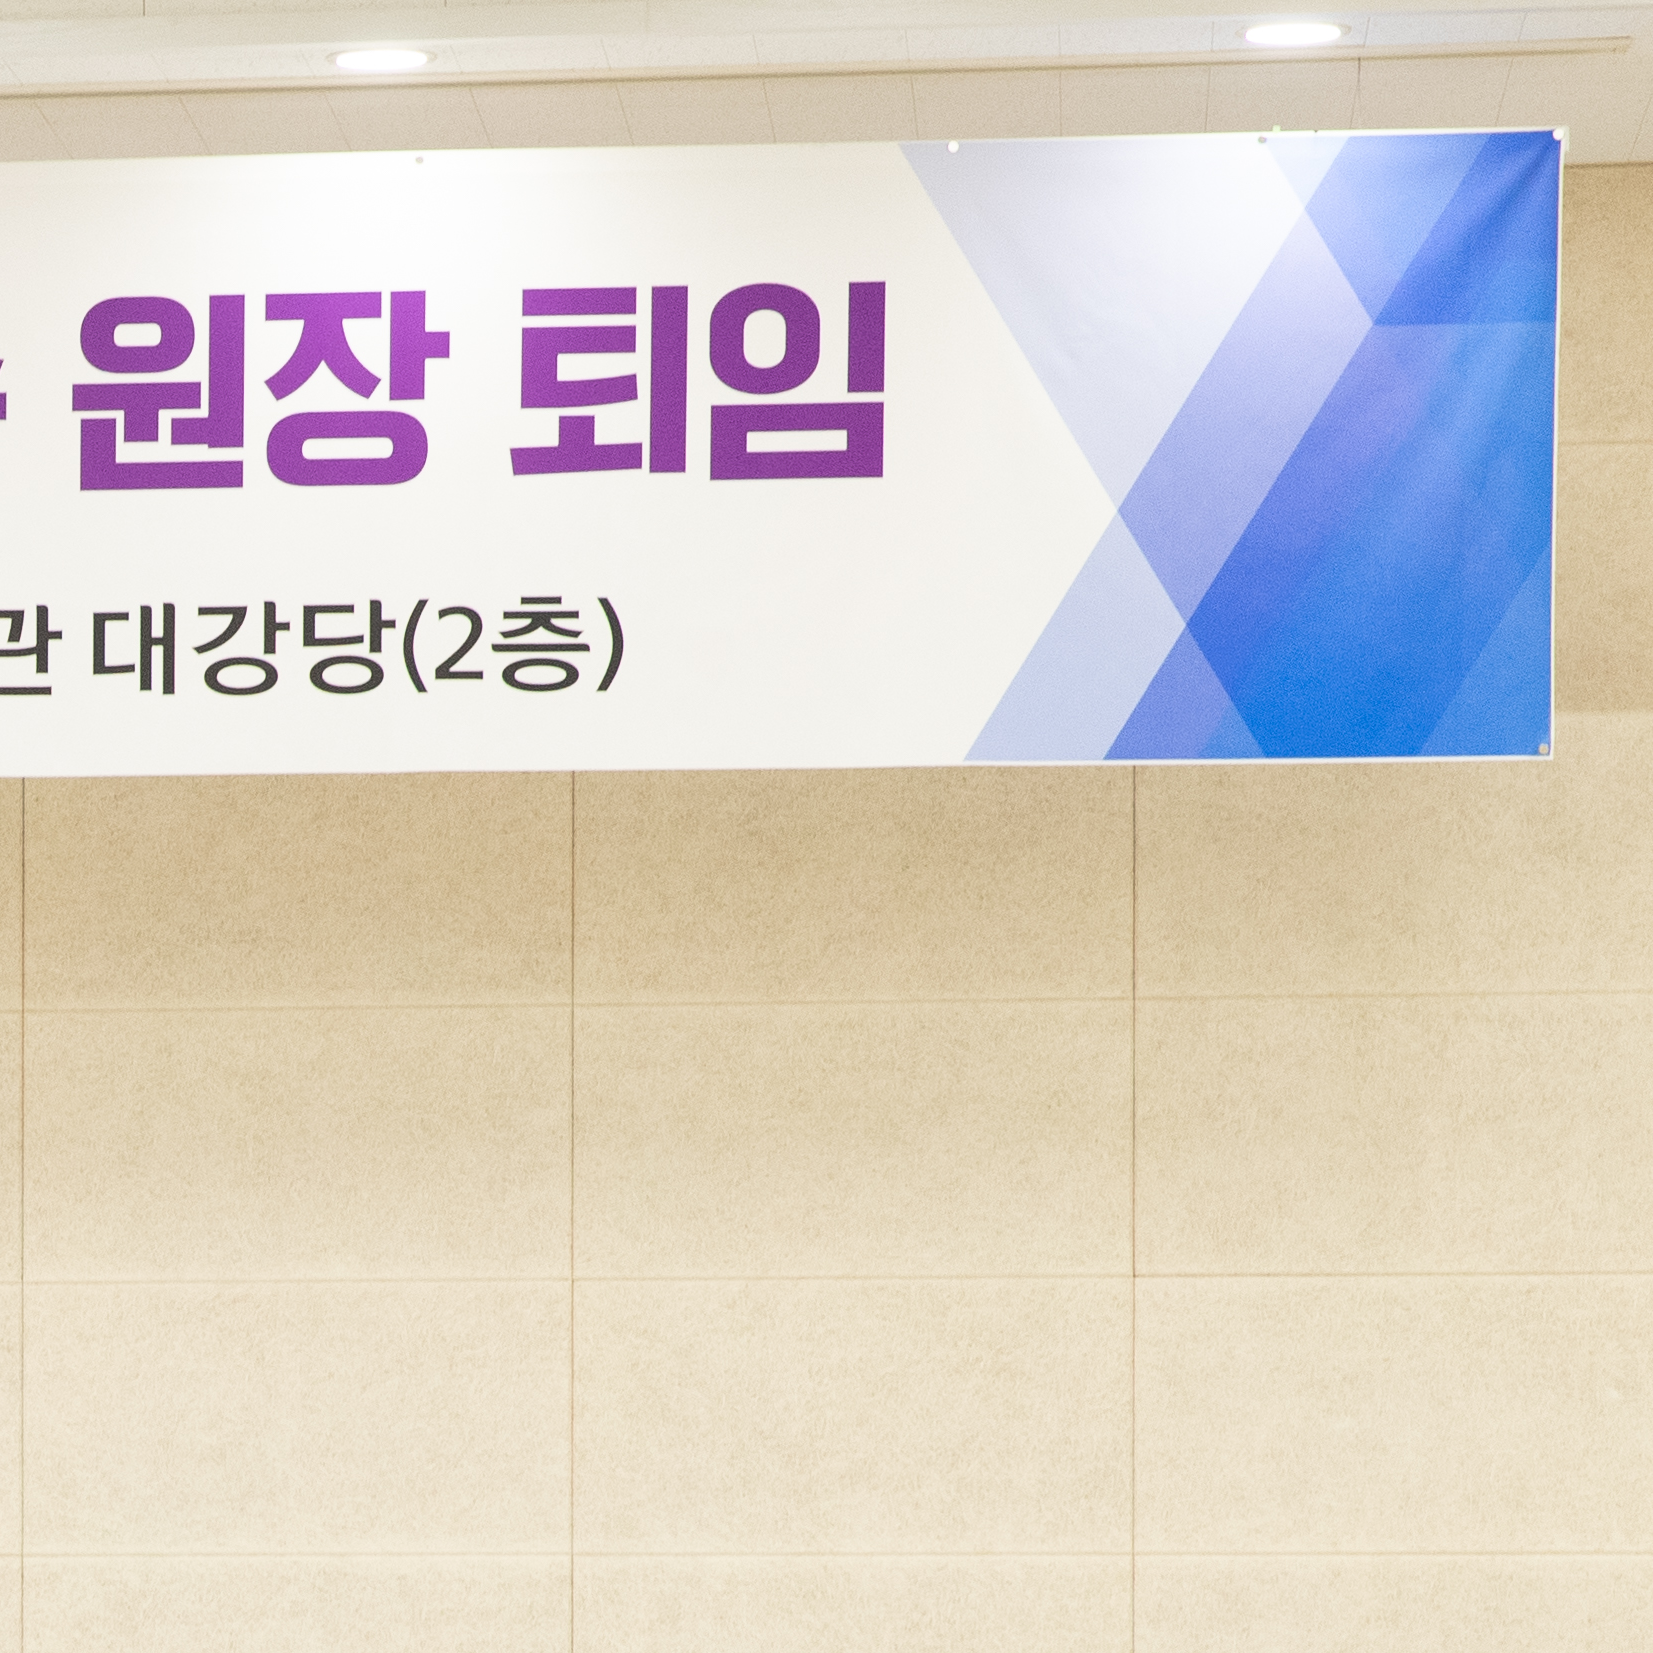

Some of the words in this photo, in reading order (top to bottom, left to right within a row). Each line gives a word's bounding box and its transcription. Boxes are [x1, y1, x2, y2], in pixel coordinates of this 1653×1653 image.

[72, 291, 450, 491] 원장
[510, 281, 886, 480] 퇴임
[93, 596, 623, 696] 대강당(2층)
